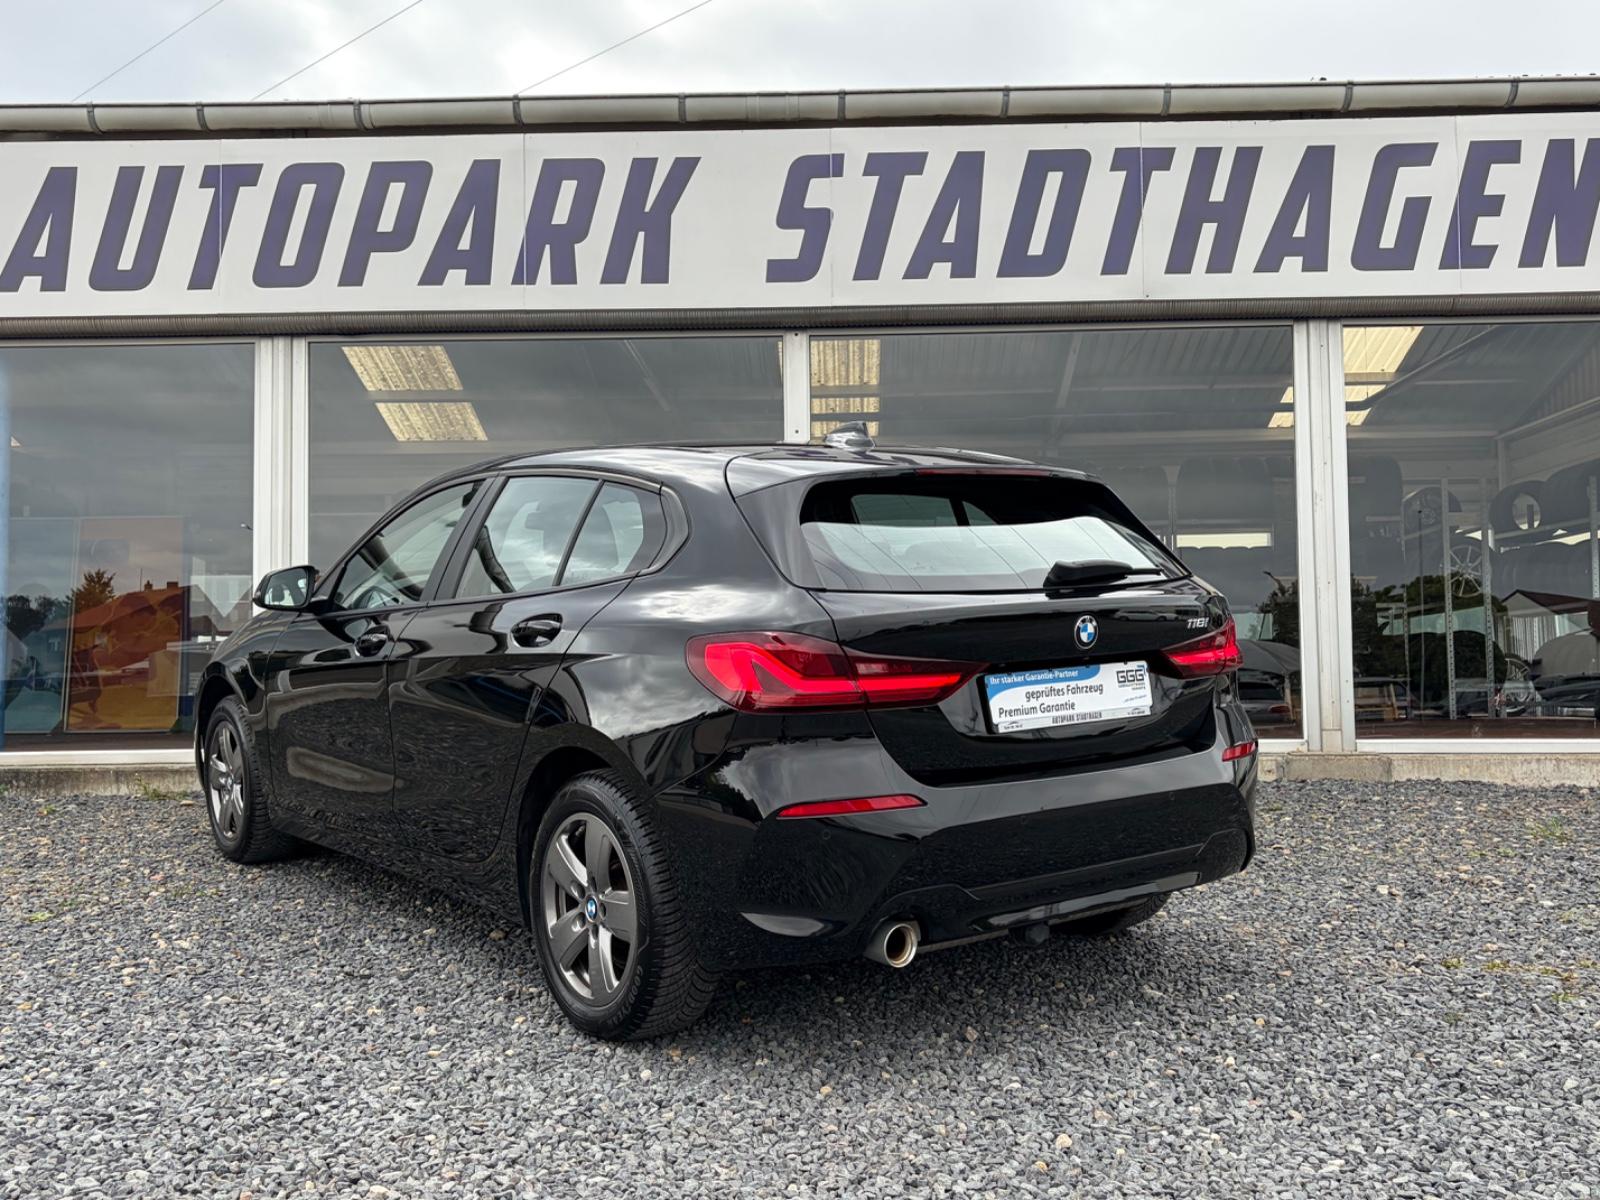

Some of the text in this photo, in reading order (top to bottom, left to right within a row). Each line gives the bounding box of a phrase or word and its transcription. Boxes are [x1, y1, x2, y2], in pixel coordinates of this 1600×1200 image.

[0, 137, 1600, 291] AUTOPARK STADTHAGEN
[1001, 675, 1024, 684] starker
[1025, 669, 1079, 680] Garantie-Partner
[1116, 668, 1144, 683] GGG
[1025, 686, 1065, 702] geprüftes
[1066, 683, 1103, 695] Fahrzeug
[998, 700, 1076, 718] Premium Garantie
